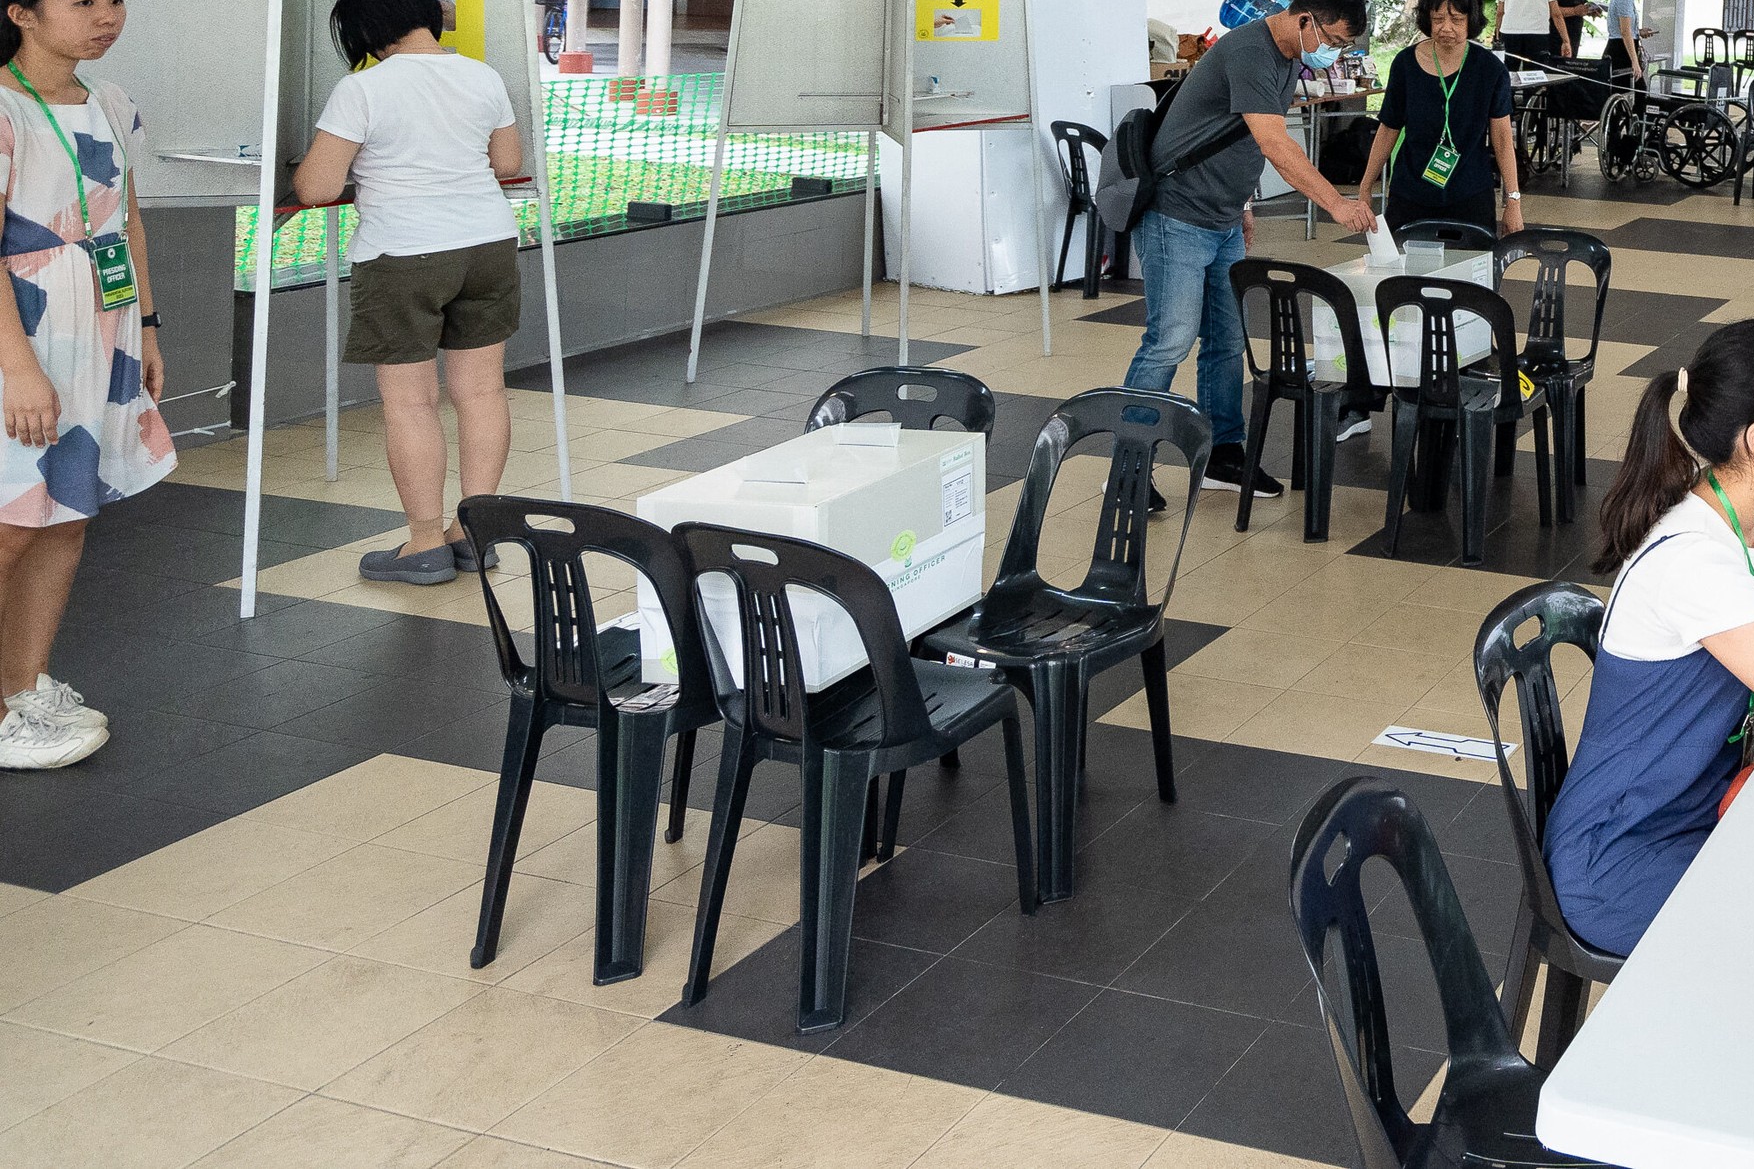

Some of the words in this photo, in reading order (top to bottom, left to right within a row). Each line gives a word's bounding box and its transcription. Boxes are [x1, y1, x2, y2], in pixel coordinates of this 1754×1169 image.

[103, 264, 126, 276] PRESIDING
[107, 272, 125, 283] OFFICER
[913, 554, 946, 576] OFFICER
